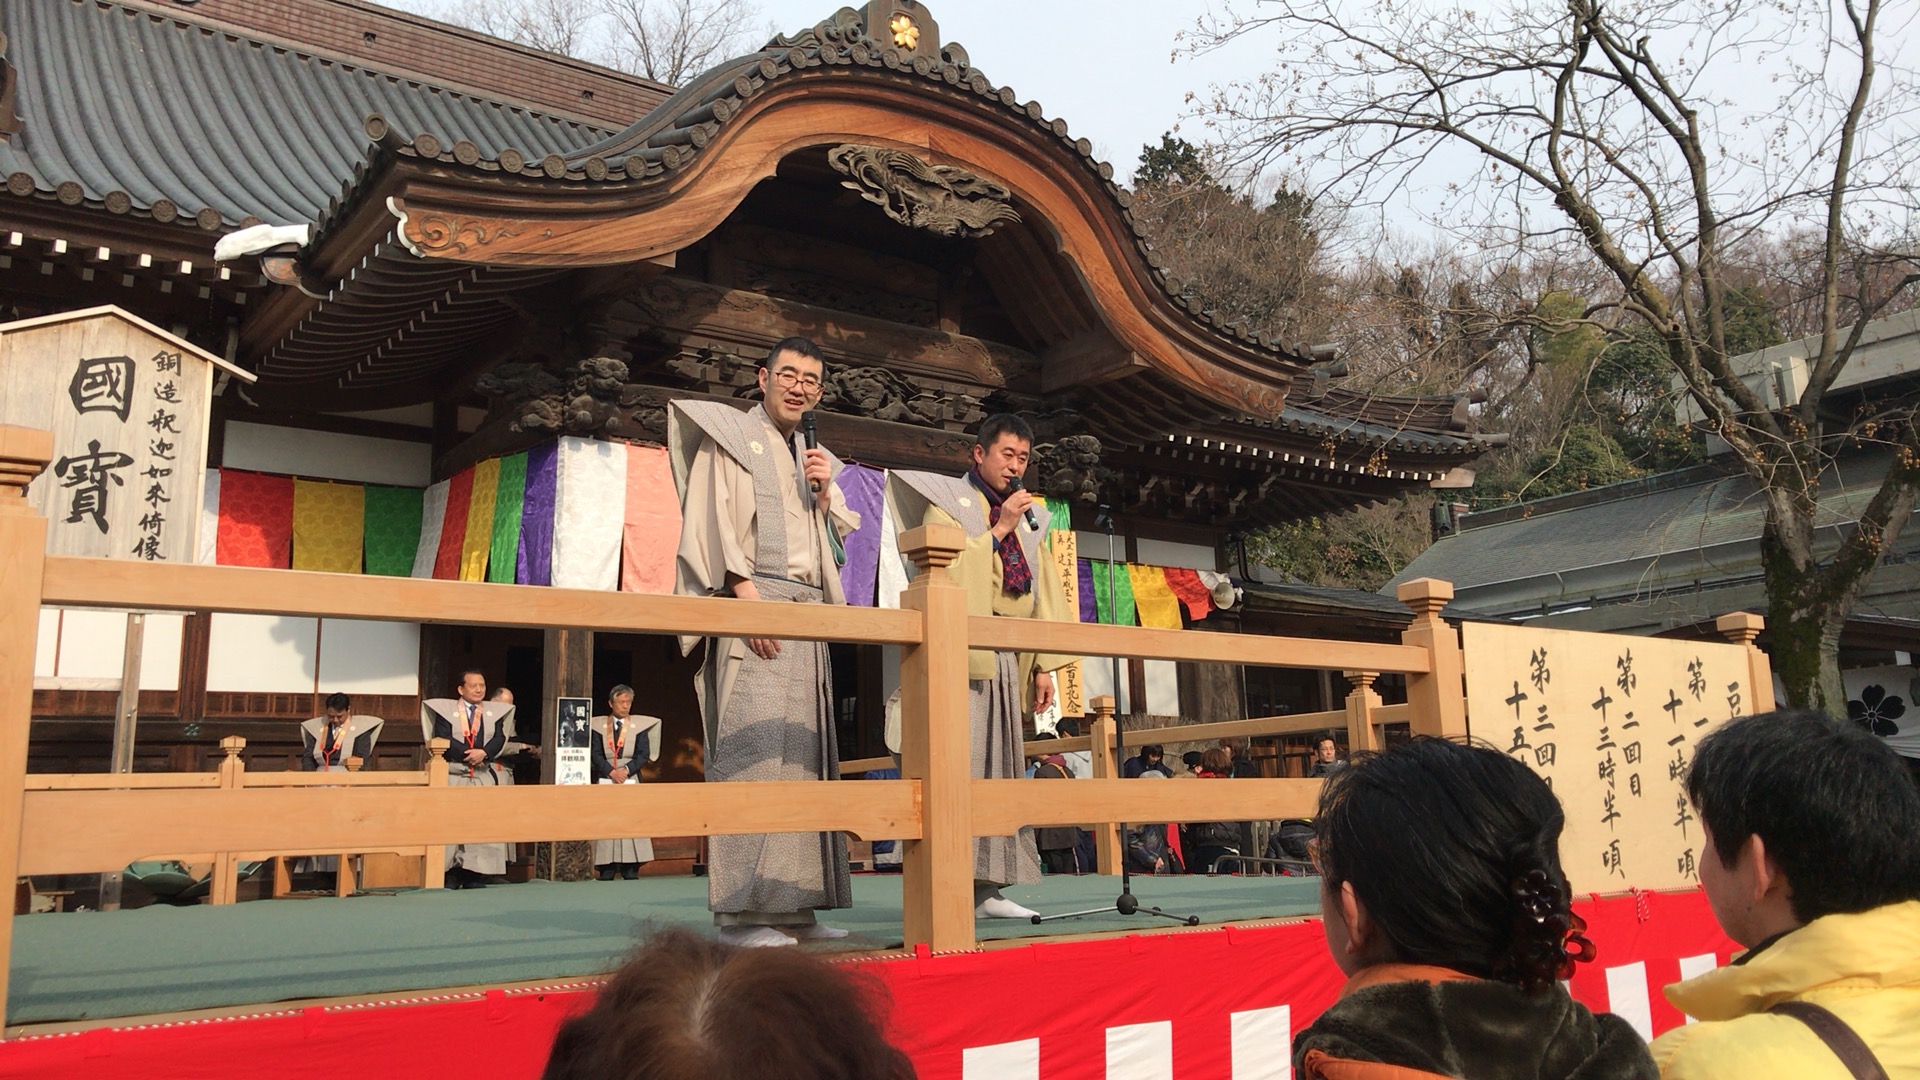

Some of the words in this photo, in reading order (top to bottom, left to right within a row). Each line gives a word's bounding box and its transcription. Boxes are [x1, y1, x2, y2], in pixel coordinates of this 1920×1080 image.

[54, 355, 136, 535] 國寶
[1505, 680, 1532, 766] 十五
[1591, 686, 1626, 879] 十三時半頃
[1616, 647, 1642, 798] 第二回目
[1662, 688, 1698, 881] 十一時半頃
[1687, 656, 1709, 750] 第一
